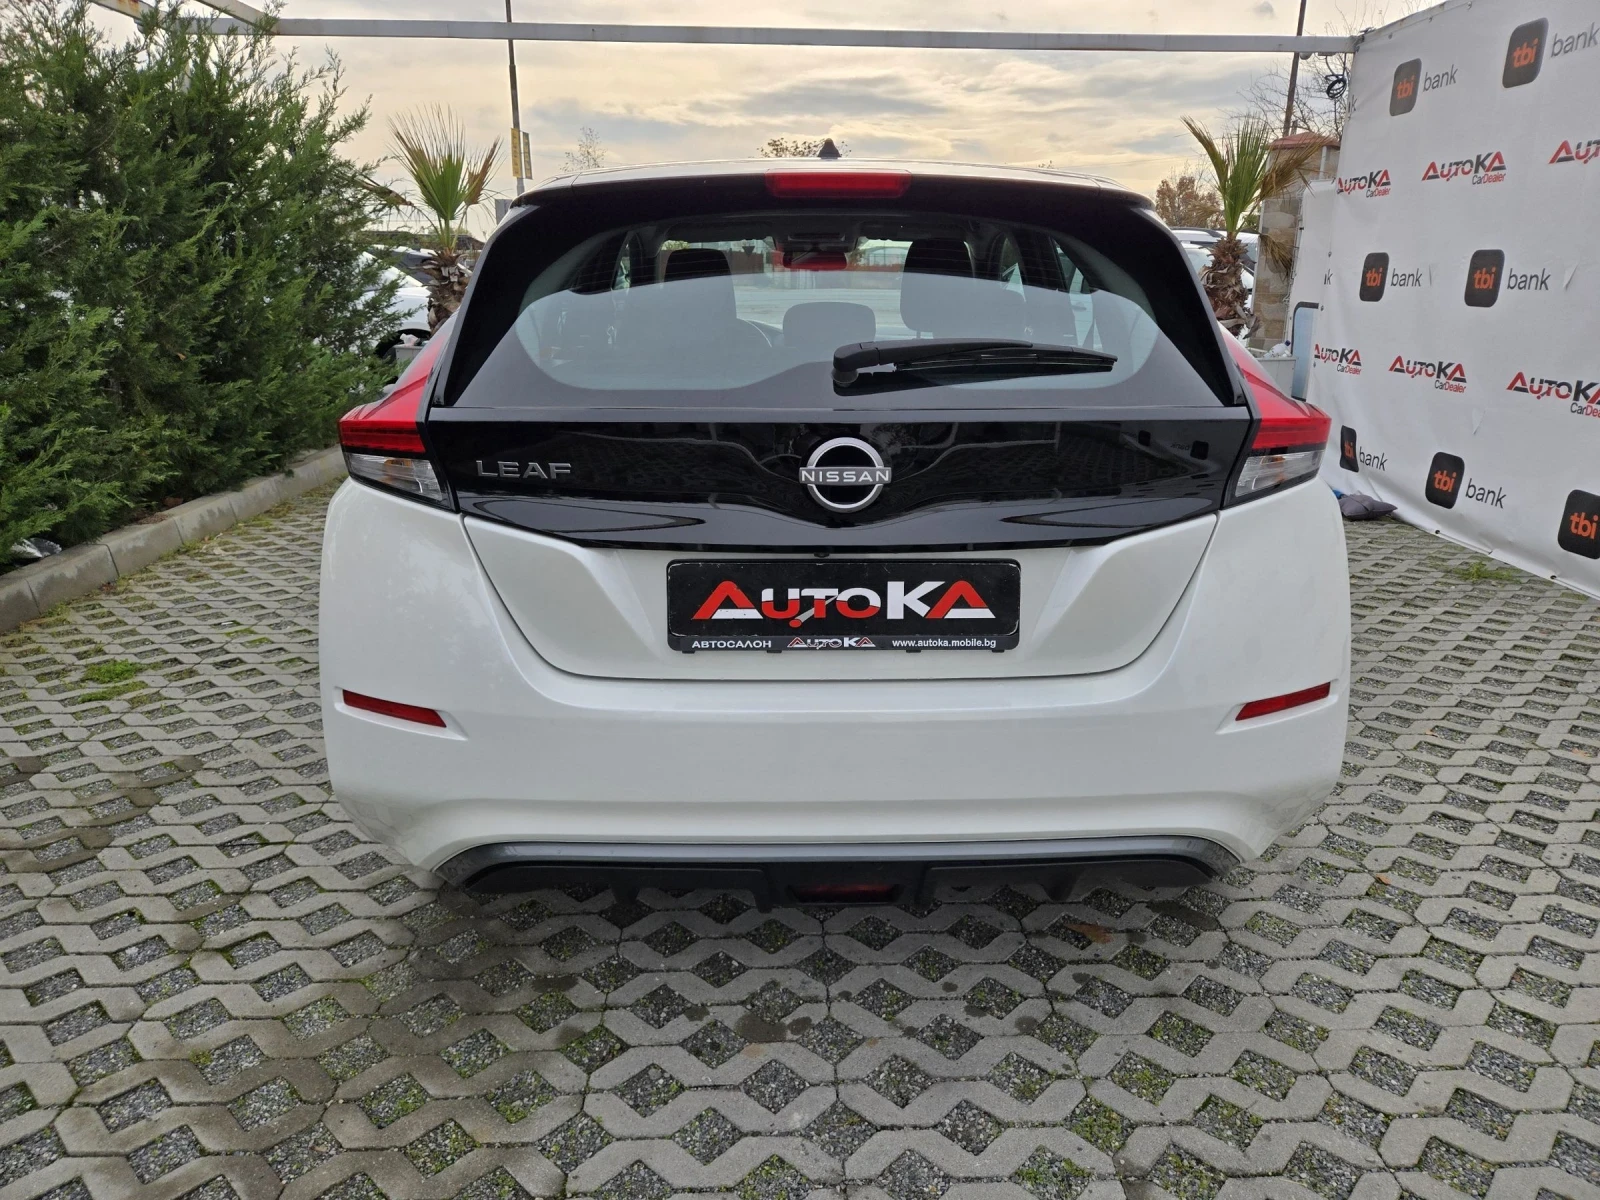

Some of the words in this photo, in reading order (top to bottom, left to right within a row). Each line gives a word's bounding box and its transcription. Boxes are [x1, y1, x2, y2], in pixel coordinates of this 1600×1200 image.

[1512, 38, 1539, 68] tbi
[1550, 22, 1600, 58] bank
[1396, 75, 1415, 99] tbi
[1422, 64, 1458, 92] bank
[1366, 267, 1383, 287] tbi
[1390, 268, 1422, 287] bank
[1473, 266, 1496, 290] tbi
[1506, 268, 1551, 291] bank
[1344, 440, 1354, 459] tbi
[1359, 446, 1388, 471] bank
[476, 460, 571, 479] LEAF
[800, 469, 890, 483] NISSAN
[1434, 470, 1457, 492] tbi
[1465, 478, 1507, 509] bank
[1570, 512, 1600, 540] tbi
[691, 639, 772, 650] АВТОСАЛОН
[892, 638, 997, 650] www.autoka.mobile.bg
